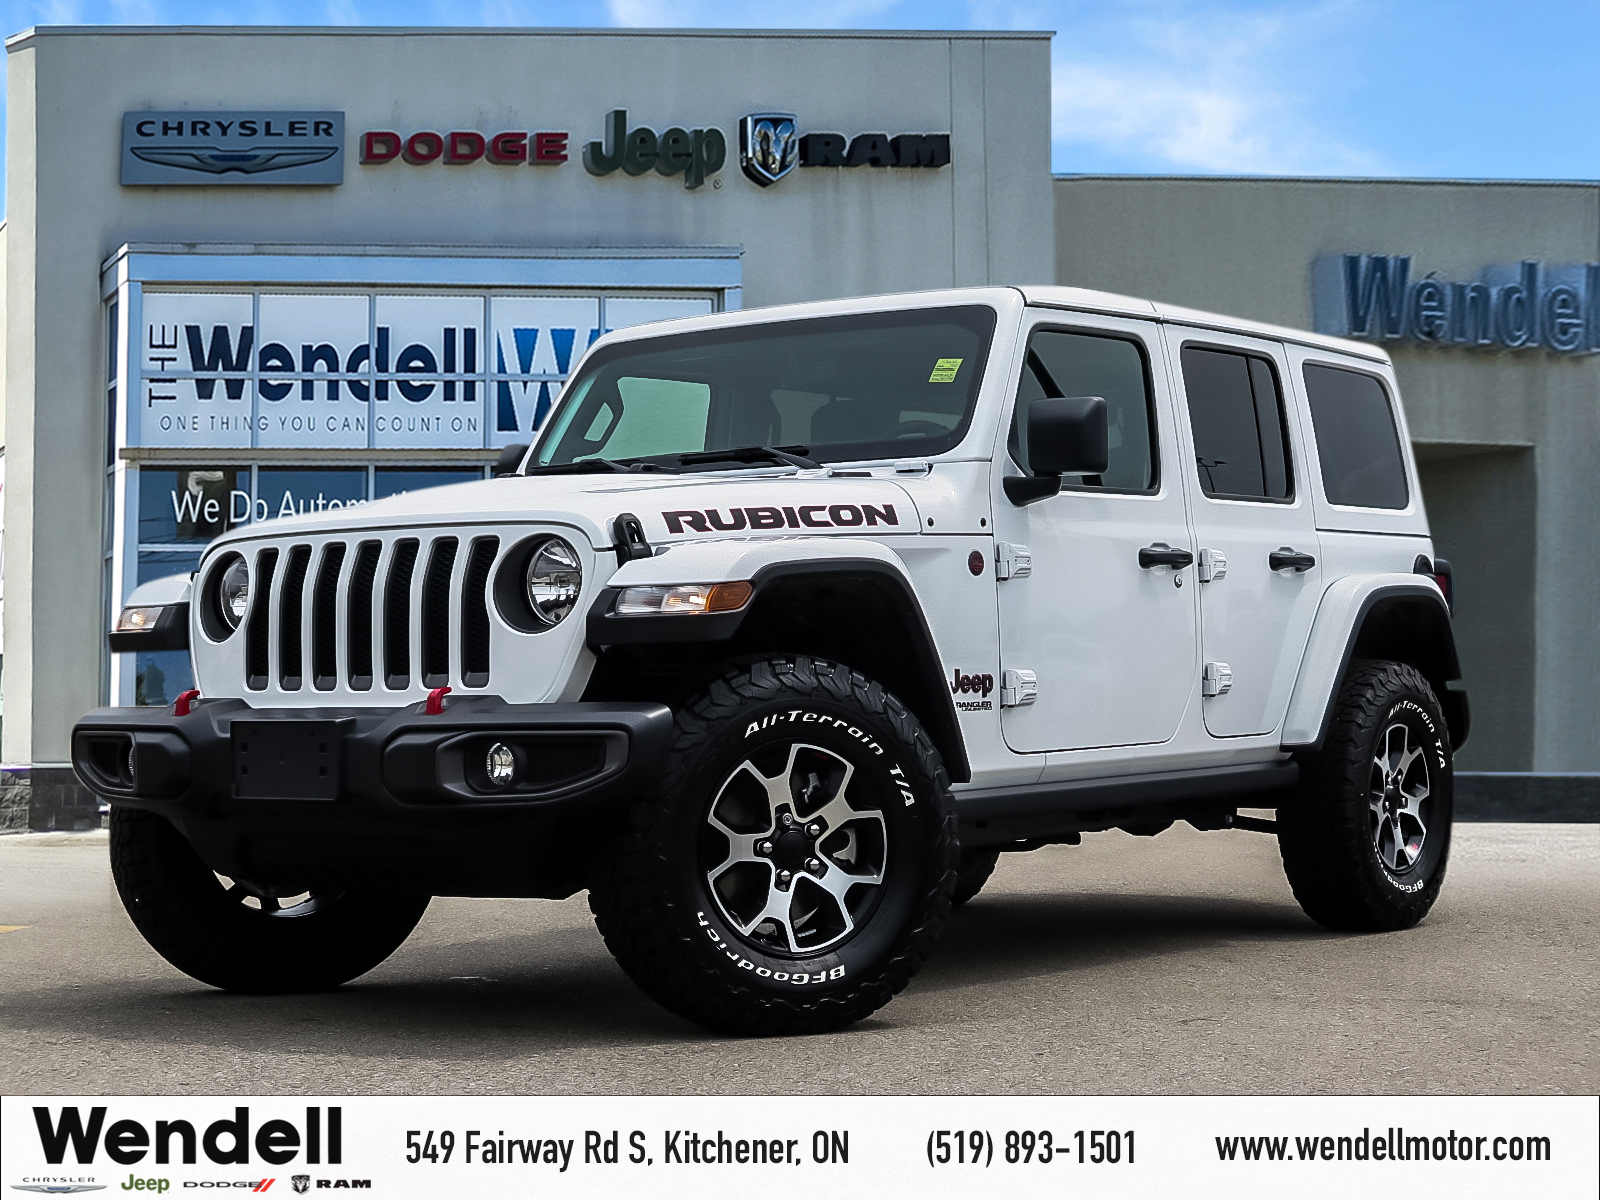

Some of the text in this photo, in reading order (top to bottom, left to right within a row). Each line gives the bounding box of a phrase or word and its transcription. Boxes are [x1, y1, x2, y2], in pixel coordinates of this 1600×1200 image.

[135, 120, 334, 137] CHRYSLER
[360, 131, 569, 165] DODGE
[582, 109, 726, 189] Jeep
[800, 133, 951, 168] RAM
[1343, 254, 1600, 351] Wendel
[148, 324, 178, 408] THE
[184, 325, 476, 401] Wendell
[160, 415, 477, 432] ONE THING YOU CAN COUNT ON
[171, 490, 220, 524] We
[230, 490, 268, 523] Do
[661, 504, 900, 534] RUBICON
[950, 668, 993, 699] Jeep
[743, 710, 916, 807] All-Terrain T/A
[1388, 700, 1447, 769] All-Terrain T/A
[697, 911, 847, 985] BFGoodrich
